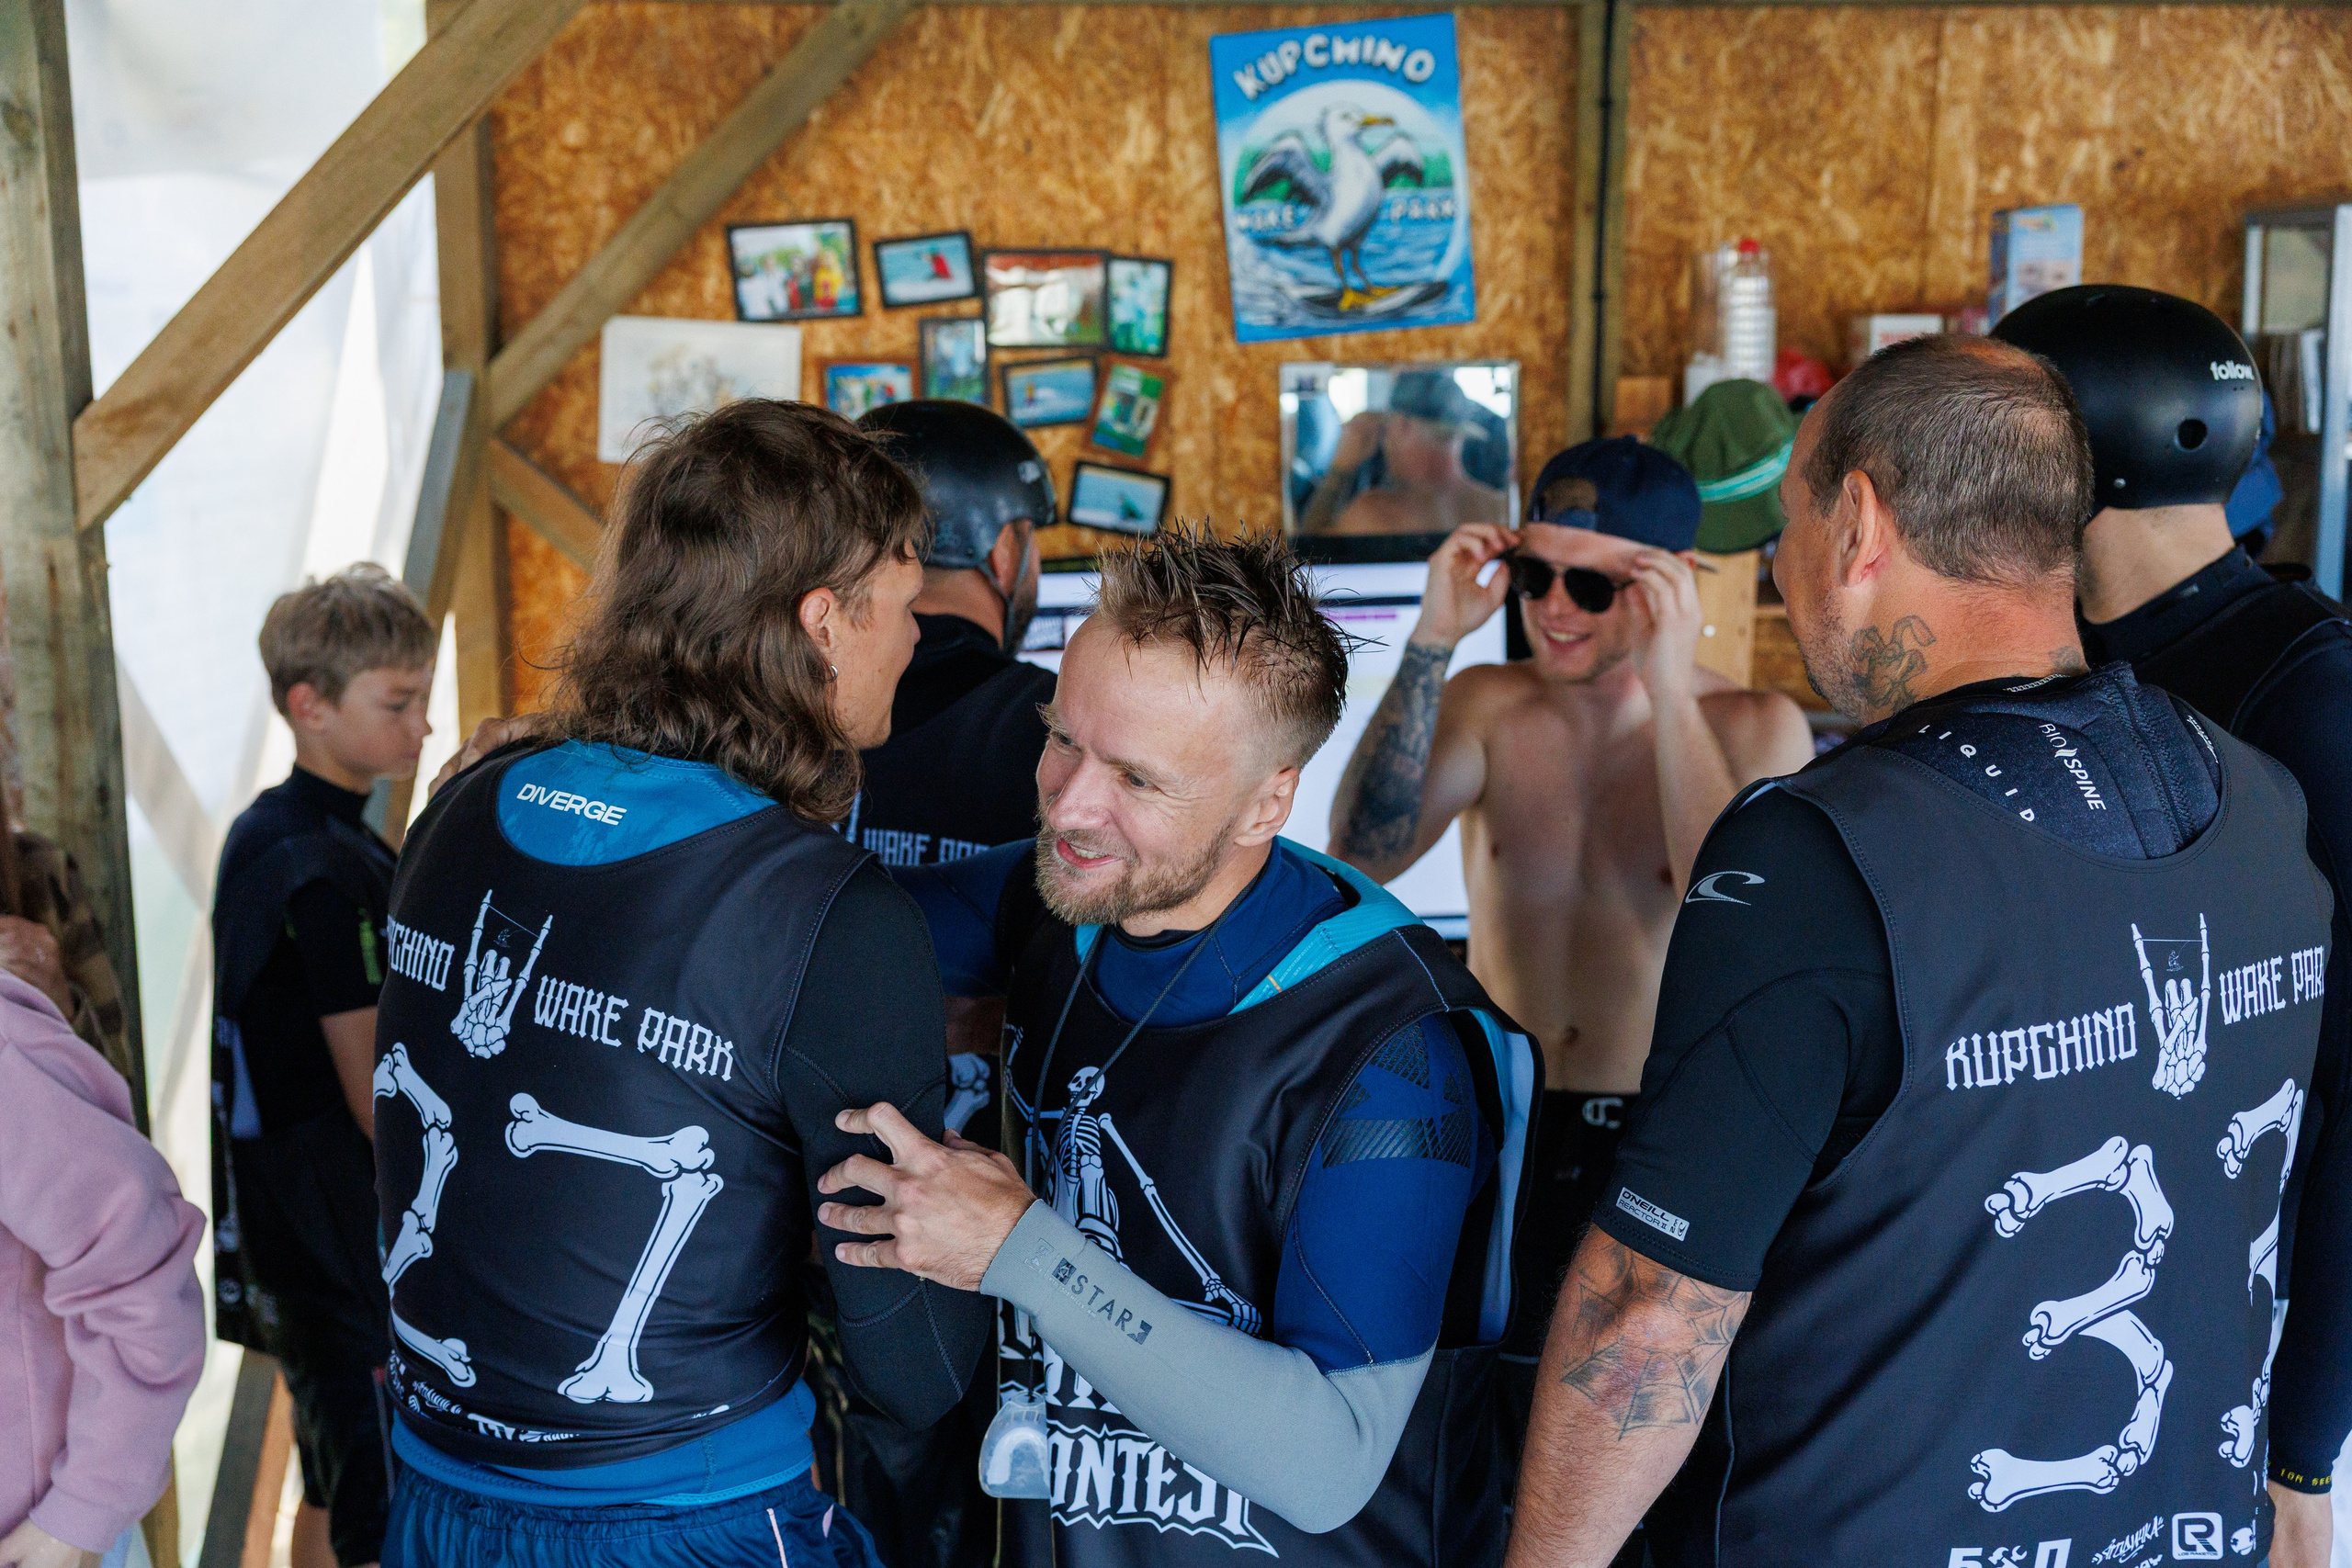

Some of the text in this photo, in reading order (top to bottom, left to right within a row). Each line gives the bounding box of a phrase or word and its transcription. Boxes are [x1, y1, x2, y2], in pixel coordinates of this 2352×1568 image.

[1233, 33, 1436, 100] KUPCHINO
[2039, 723, 2107, 811] BIO SPINE
[516, 783, 628, 826] DIVERGE
[534, 975, 629, 1047] WAKE
[637, 1007, 734, 1082] PARK
[1945, 945, 2324, 1091] KUPCHINO WAKE PAR
[1619, 1199, 1661, 1227] REACTOR
[1070, 1273, 1134, 1332] STAR
